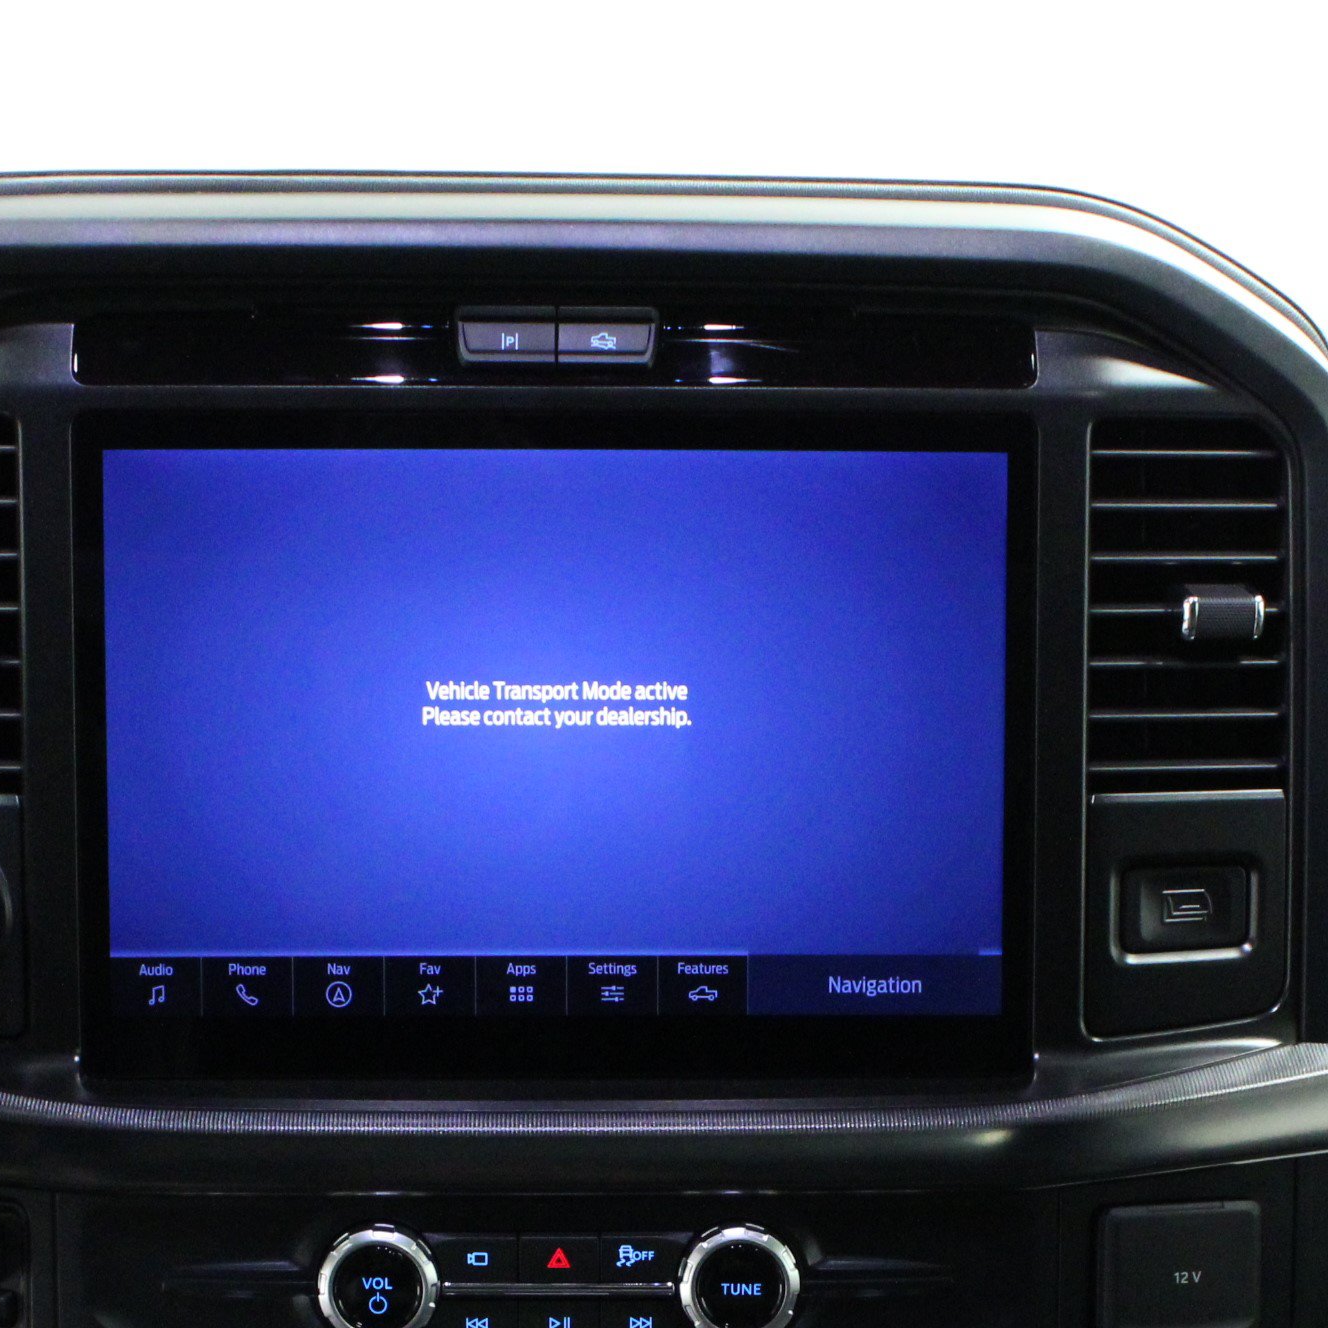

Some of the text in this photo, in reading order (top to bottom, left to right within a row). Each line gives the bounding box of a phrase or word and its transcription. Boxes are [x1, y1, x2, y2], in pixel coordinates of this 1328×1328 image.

[425, 680, 689, 703] Vehicle Transport Mode active
[421, 706, 693, 729] Please contact your dealership.
[138, 963, 174, 976] Audio
[228, 963, 267, 976] Phone
[327, 963, 351, 975] Nav
[419, 963, 441, 975] Fav
[506, 963, 537, 978] Apps
[588, 962, 638, 977] Settings
[677, 962, 729, 976] Features
[828, 975, 923, 997] Navigation
[634, 1250, 655, 1262] OFF
[362, 1277, 393, 1290] VOL
[1174, 1270, 1202, 1284] 12 V
[721, 1283, 762, 1296] TUNE
